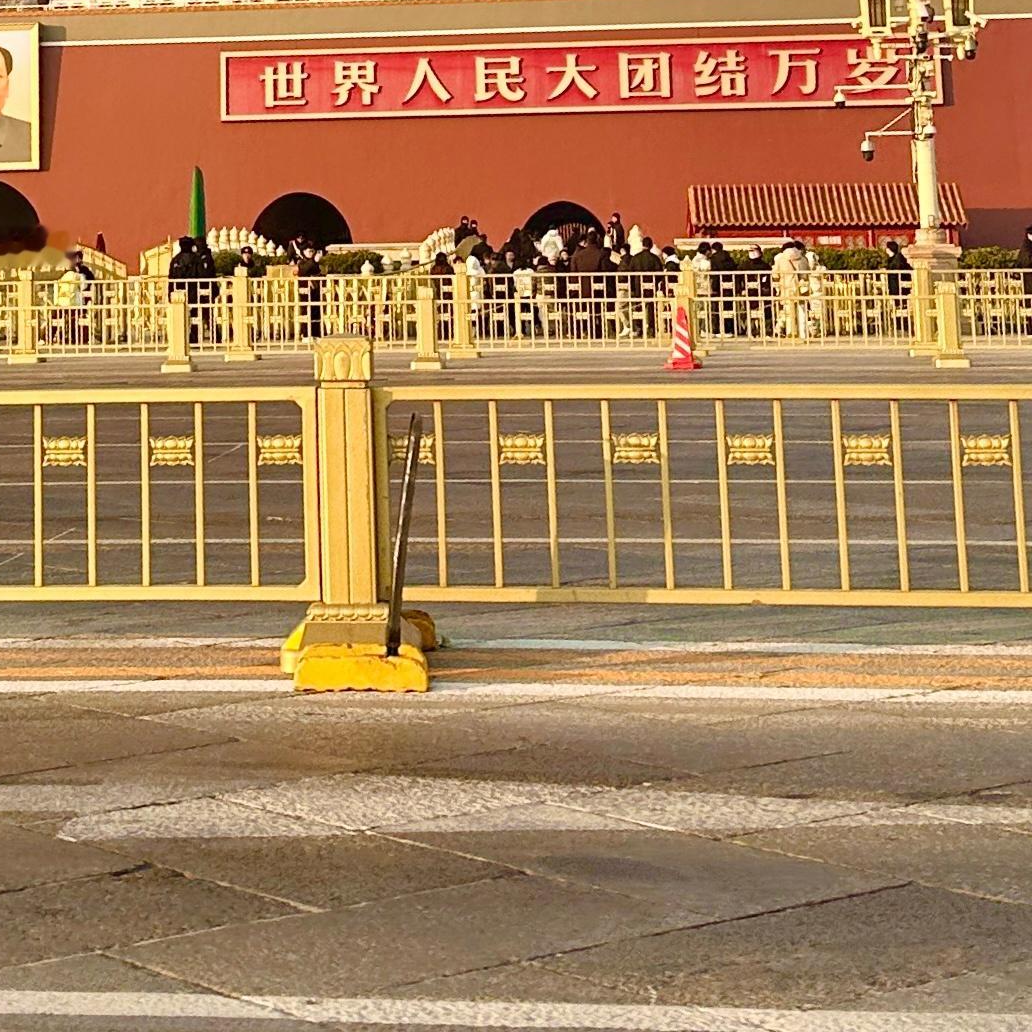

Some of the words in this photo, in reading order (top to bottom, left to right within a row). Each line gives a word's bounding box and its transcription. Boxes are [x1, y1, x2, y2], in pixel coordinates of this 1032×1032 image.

[259, 47, 899, 108] 世界人民大团结万岁
